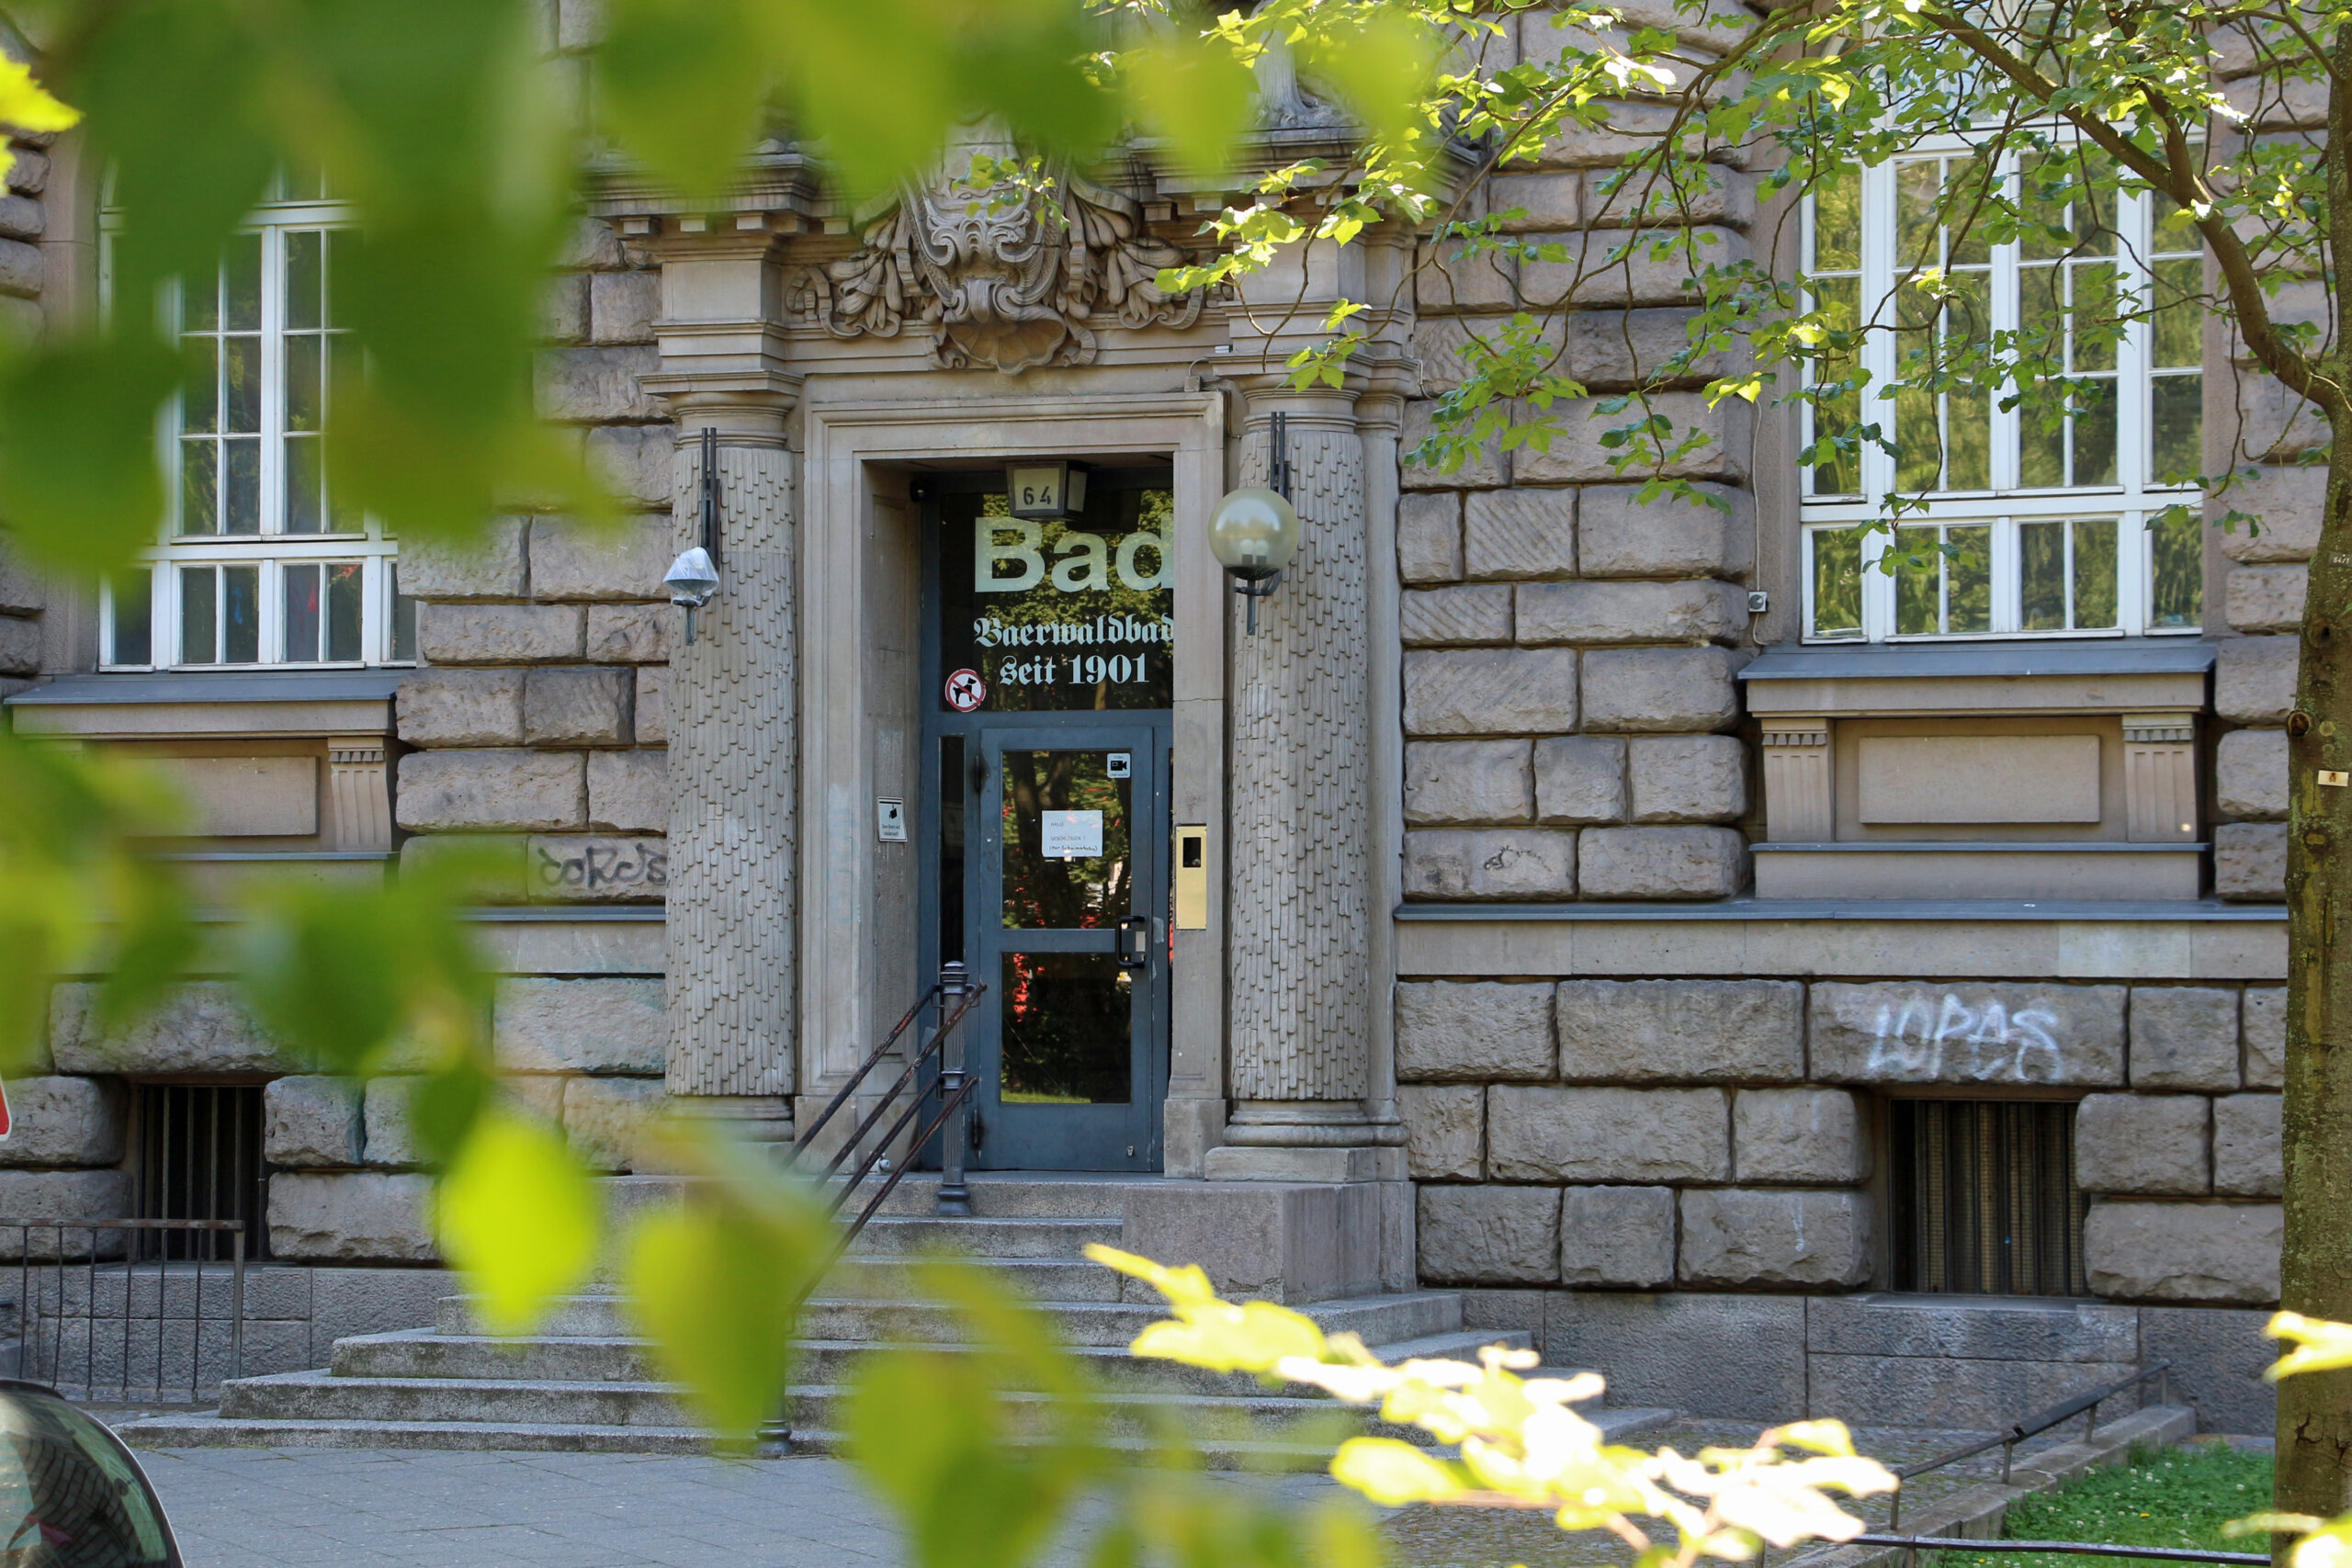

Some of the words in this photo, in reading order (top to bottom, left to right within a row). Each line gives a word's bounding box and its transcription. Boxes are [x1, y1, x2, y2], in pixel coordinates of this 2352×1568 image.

[1023, 486, 1052, 506] 64
[975, 513, 1174, 592] Bad
[974, 613, 1174, 647] Baerwaldbad
[1000, 655, 1057, 685] seit
[1069, 653, 1149, 685] 1901
